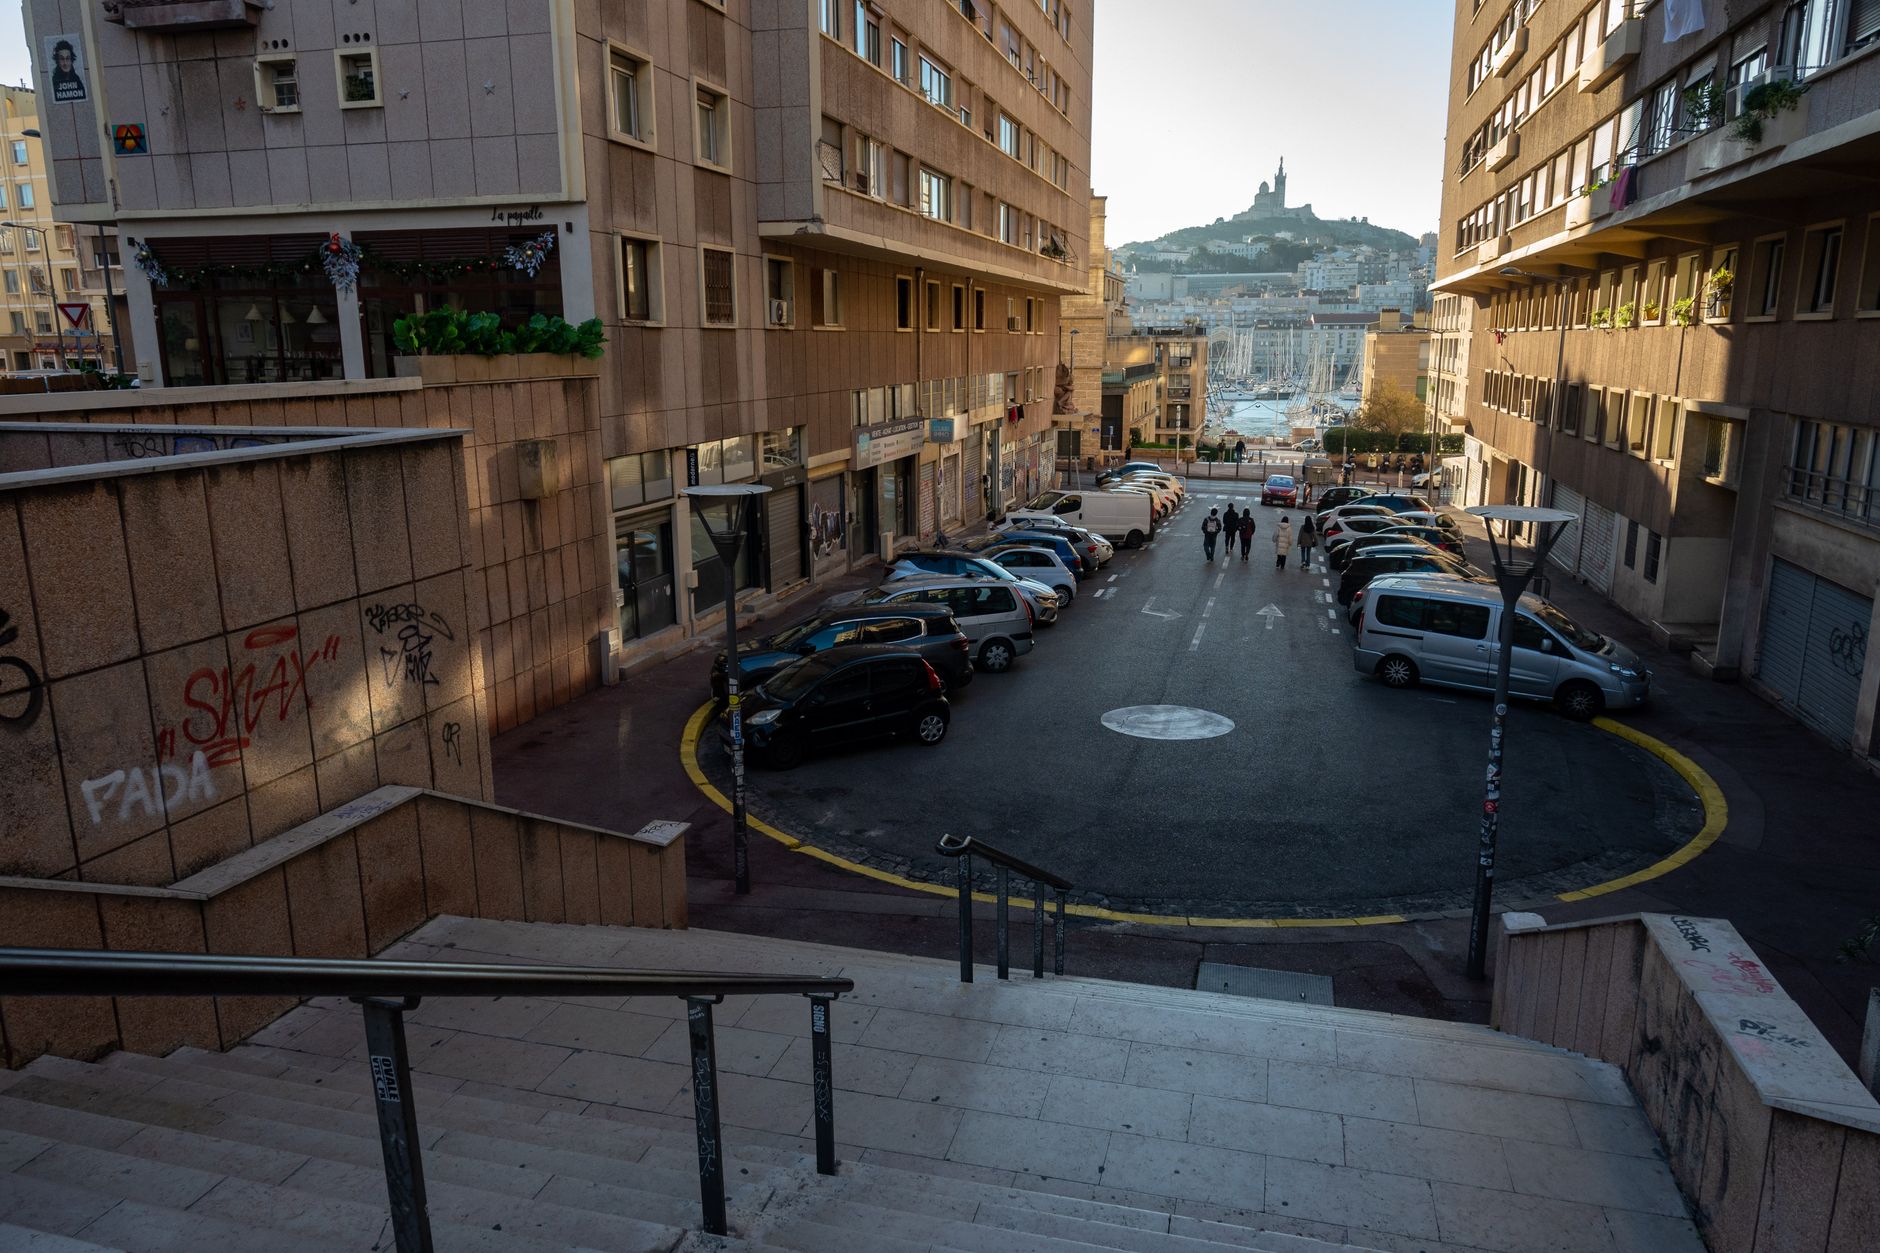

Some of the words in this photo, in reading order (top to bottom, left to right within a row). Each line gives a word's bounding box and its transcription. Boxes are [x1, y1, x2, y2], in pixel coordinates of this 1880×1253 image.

[59, 82, 78, 91] JOHN
[57, 90, 84, 99] HAMON
[812, 1004, 825, 1034] SIGNO
